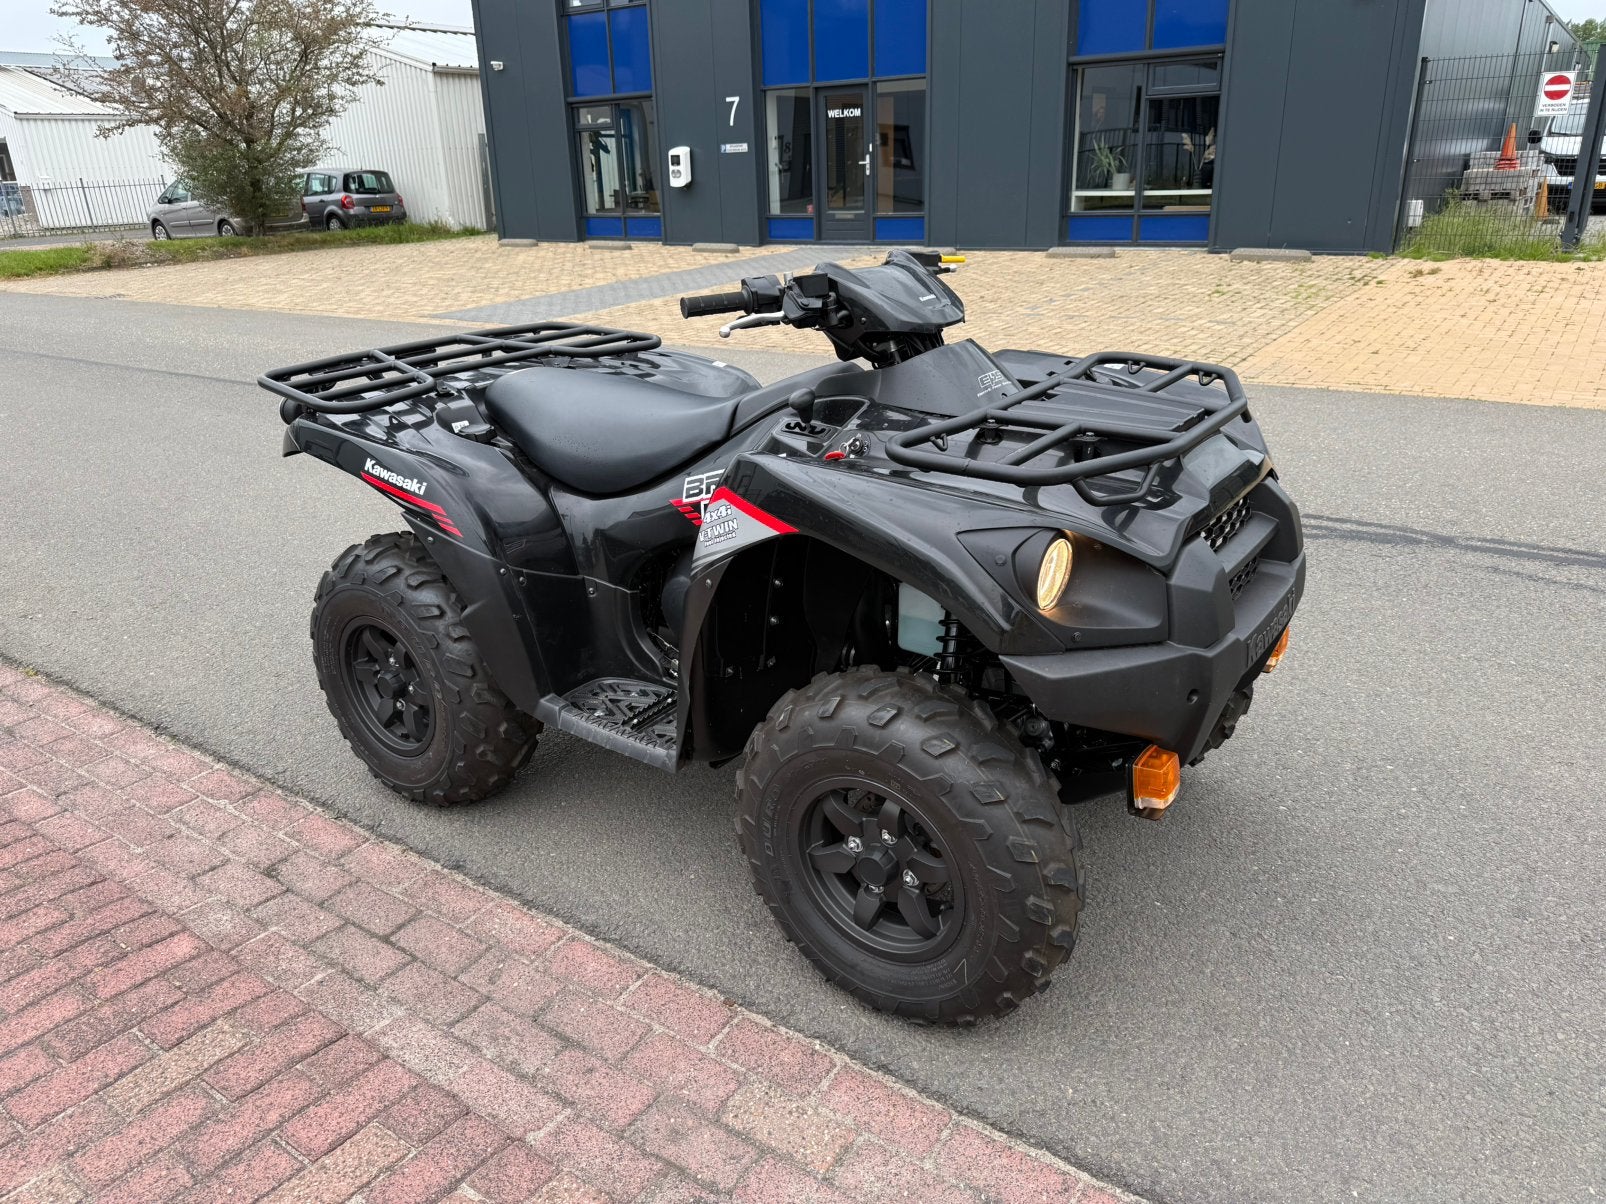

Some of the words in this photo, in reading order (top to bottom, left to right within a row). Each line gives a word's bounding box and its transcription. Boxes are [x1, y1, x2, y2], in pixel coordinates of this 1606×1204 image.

[725, 96, 740, 126] 7
[827, 107, 862, 118] WELKOM
[364, 457, 428, 496] Kawasaki
[703, 504, 733, 524] 4x4i
[1247, 587, 1296, 669] Kawasaki
